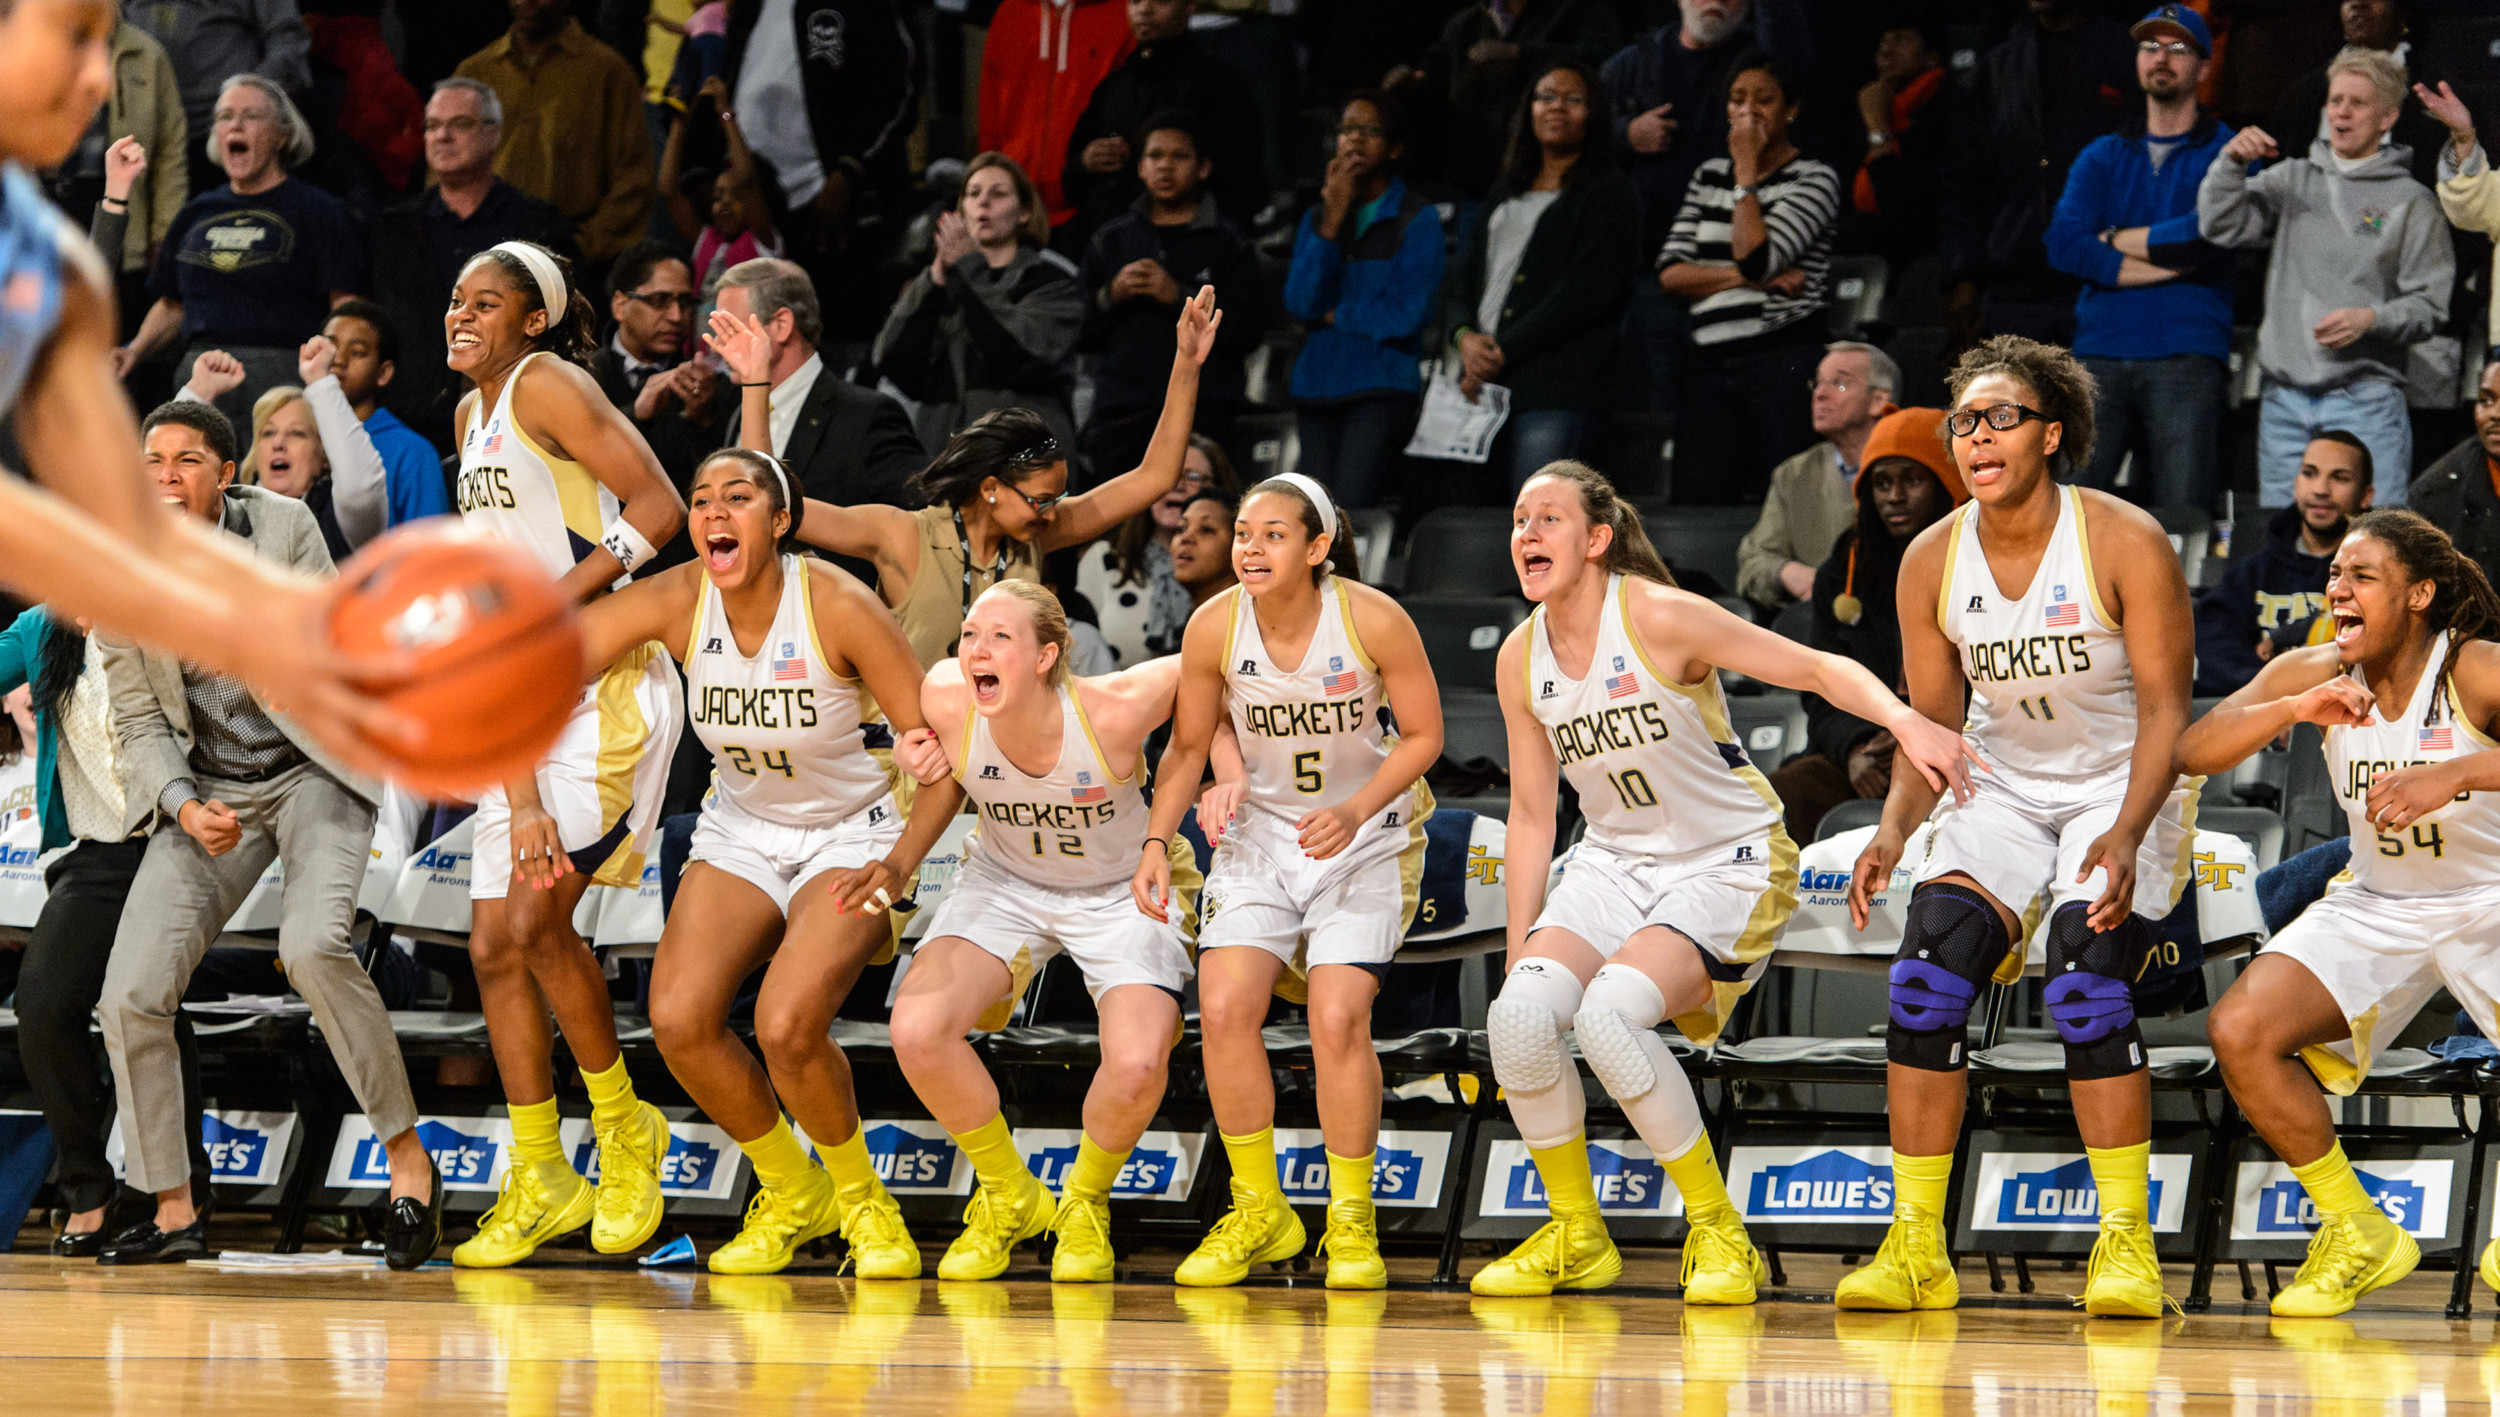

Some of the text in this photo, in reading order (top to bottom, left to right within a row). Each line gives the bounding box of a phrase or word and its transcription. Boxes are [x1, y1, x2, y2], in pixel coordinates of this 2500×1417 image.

[1968, 634, 2092, 682] JACKETS
[694, 685, 818, 730] JACKETS
[1245, 696, 1364, 738] JACKETS
[2019, 694, 2056, 722] 11
[1551, 701, 1670, 766] JACKETS
[722, 744, 796, 779] 24
[1293, 750, 1324, 795] 5
[1606, 767, 1660, 811] 10
[984, 799, 1115, 830] JACKETS
[1031, 831, 1086, 857] 12
[2375, 822, 2445, 859] 54
[1422, 898, 1437, 922] 5
[365, 1143, 481, 1178] LE'S
[585, 1148, 702, 1185] LE'S
[869, 1149, 939, 1182] WE'S
[1521, 1169, 1648, 1203] LE'S
[1764, 1175, 1893, 1210] LOWE'S
